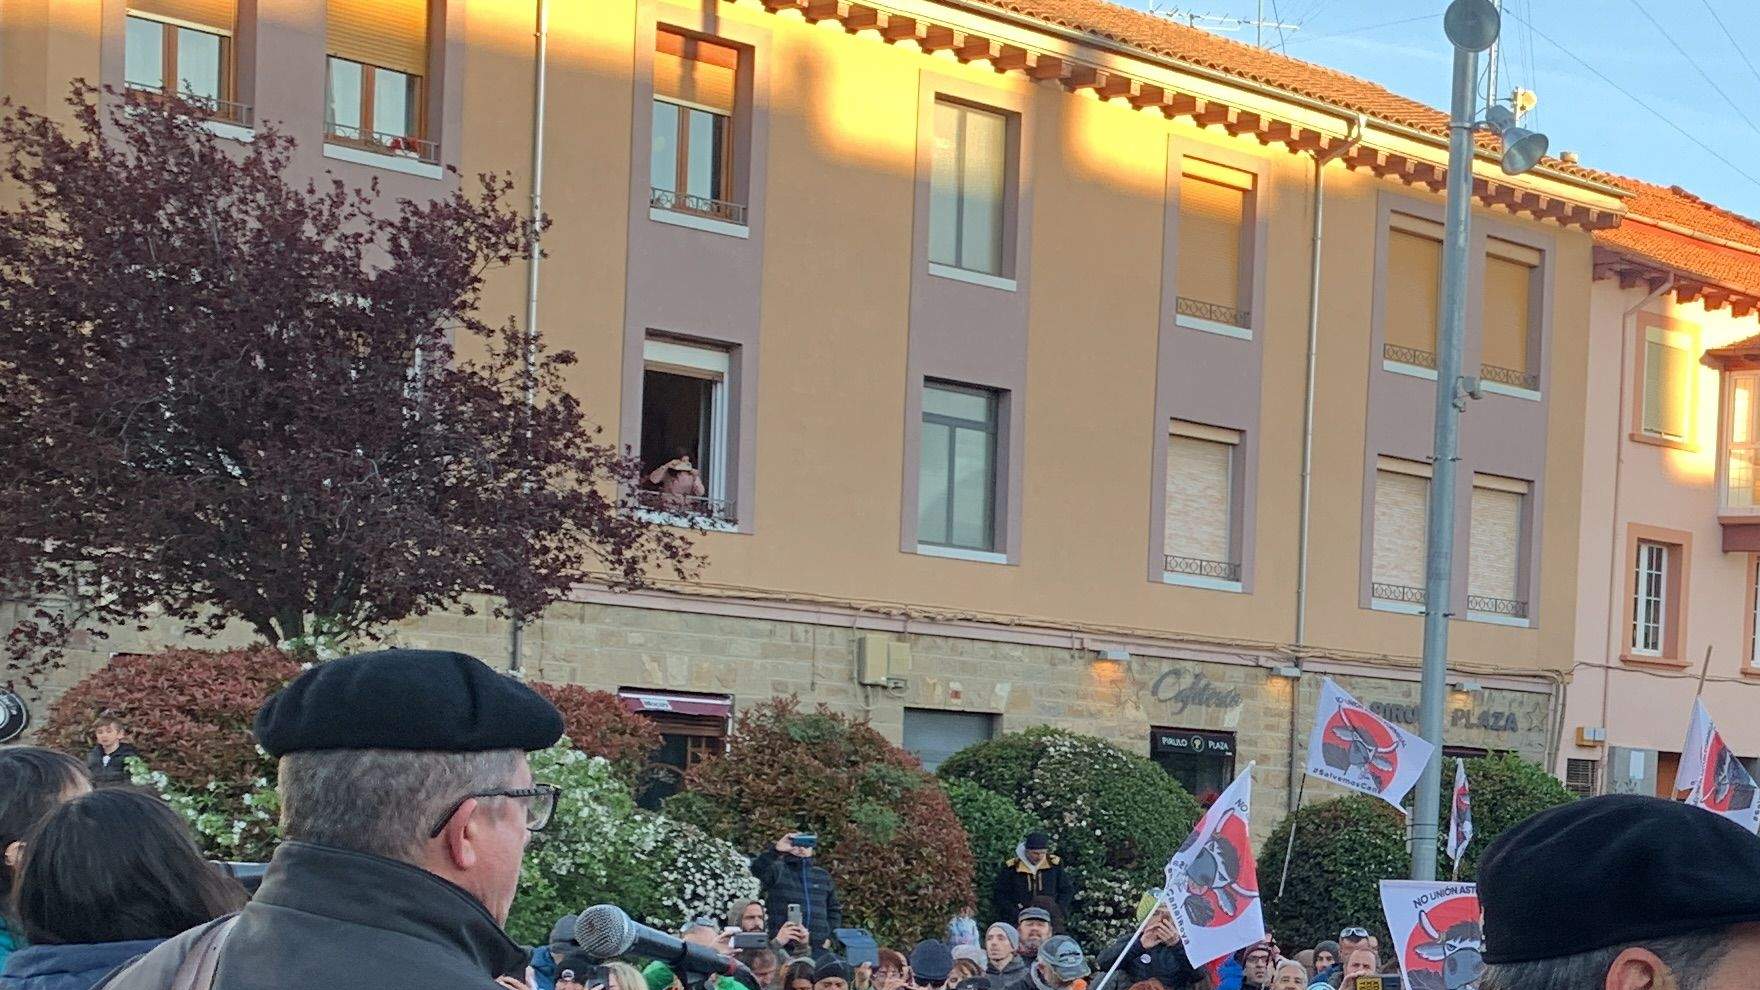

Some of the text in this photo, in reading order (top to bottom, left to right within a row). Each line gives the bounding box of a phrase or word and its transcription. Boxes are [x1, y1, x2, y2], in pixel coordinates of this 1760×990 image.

[1451, 708, 1519, 733] PLAZA
[1208, 740, 1230, 750] PLAZA
[1413, 894, 1429, 908] NO
